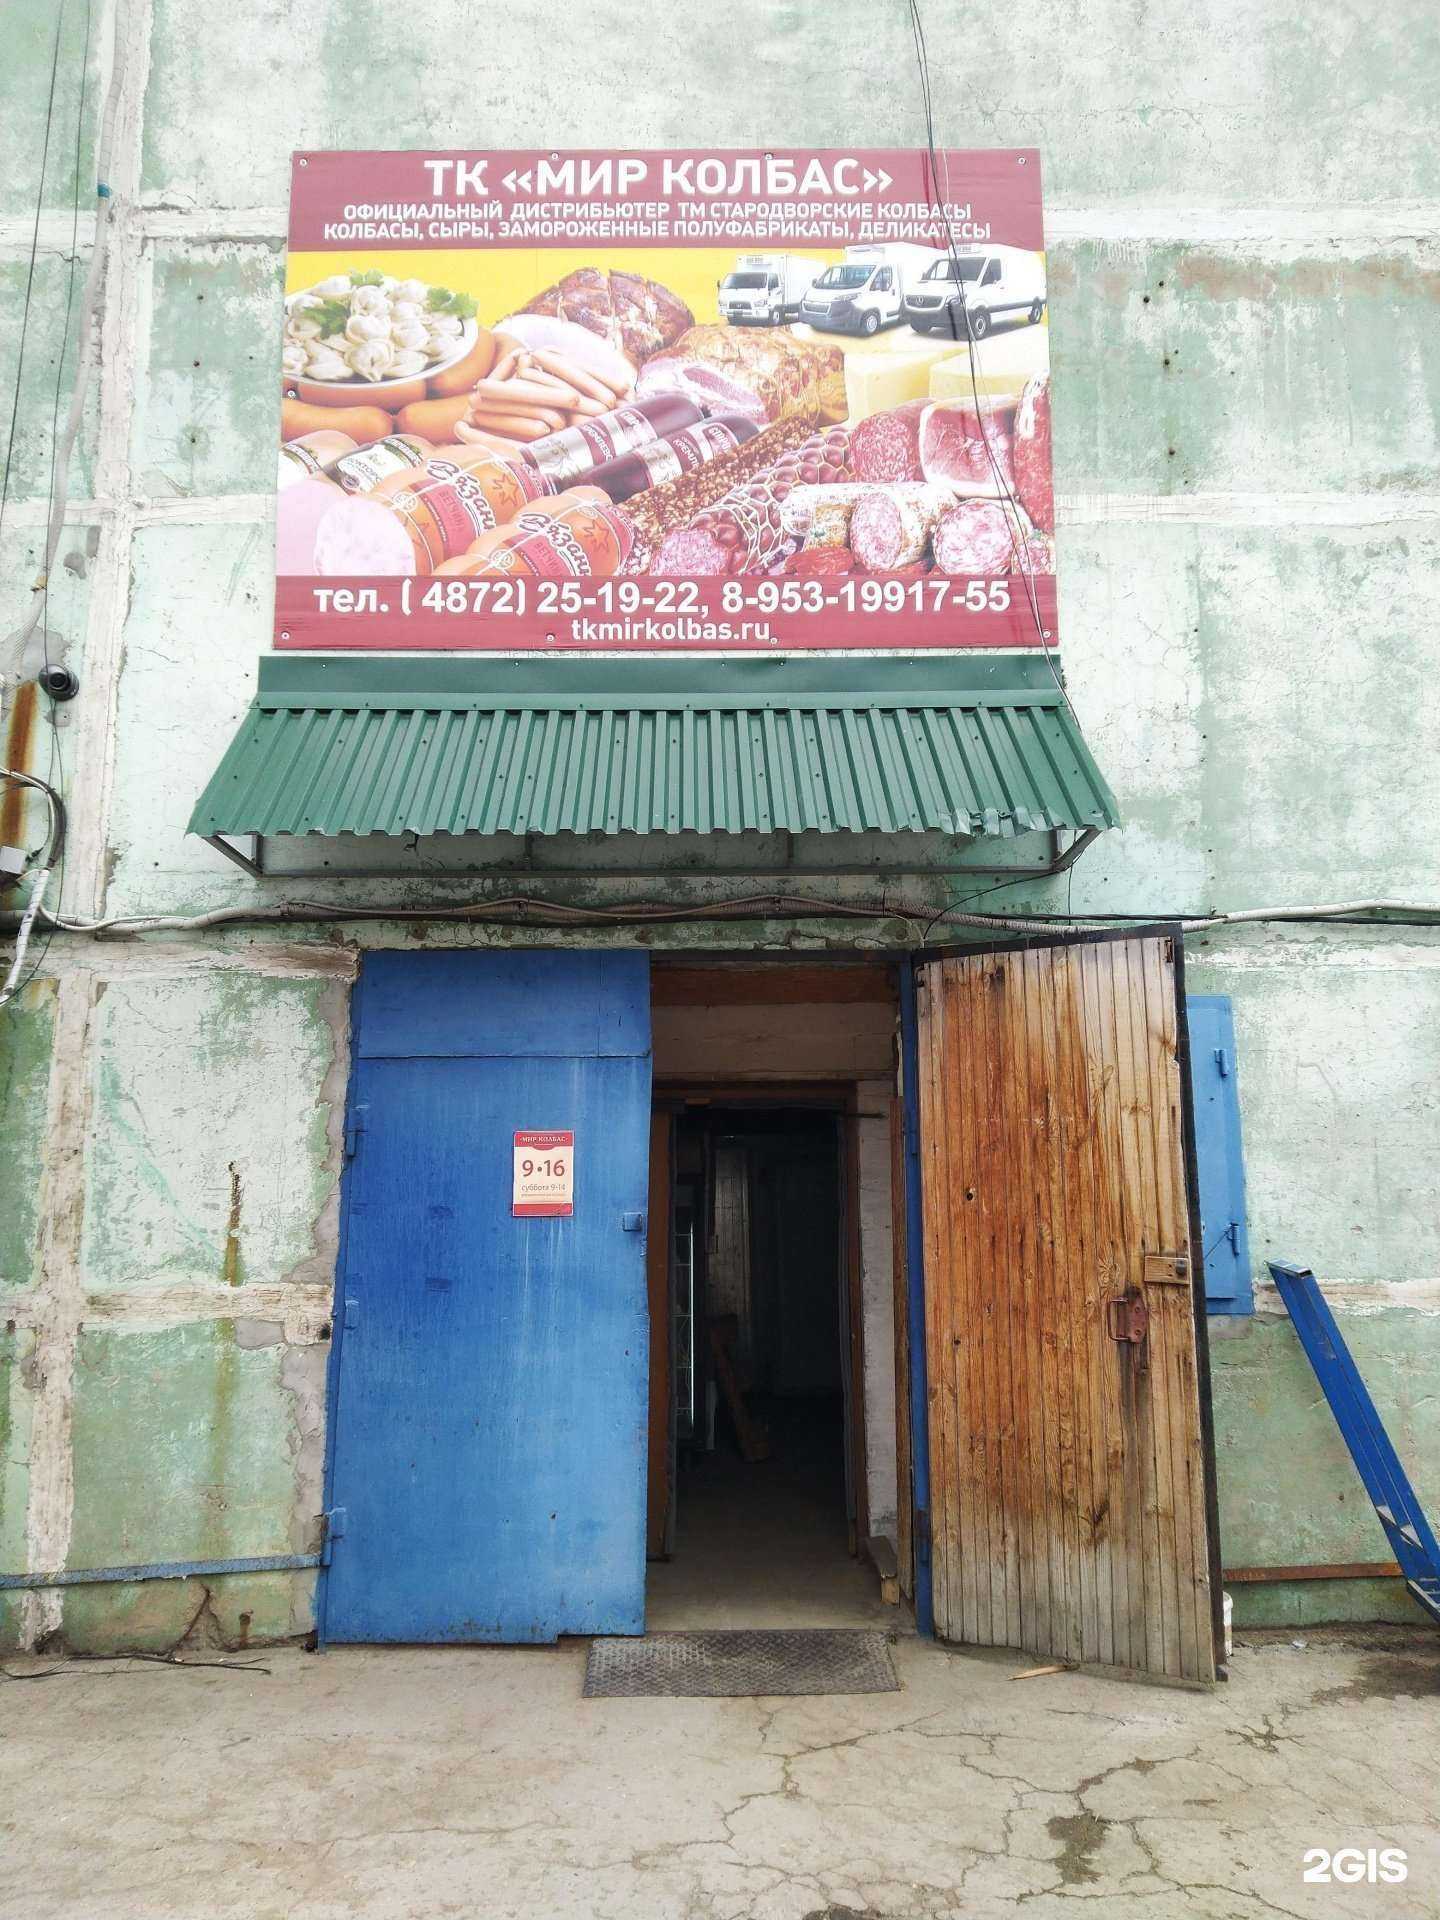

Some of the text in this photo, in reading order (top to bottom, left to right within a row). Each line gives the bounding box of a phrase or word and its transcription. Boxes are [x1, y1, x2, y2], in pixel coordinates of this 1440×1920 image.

[424, 158, 893, 195] ТК «МИР КОЛБАС»
[343, 200, 971, 221] ОФИЦИАЛЬНЫЙ ДИСТРИБЬЮТЕР ТМ СТАРОДВОРСКИЕ КОЛБАСЫ
[324, 220, 991, 241] КОЛБАСЫ, СЫРЫ, ЗАМОРОЖЕННЫЕ ПОЛУФАБРИКАТЫ, ДЕЛИКАТЕСЫ
[313, 588, 389, 613] тел.
[537, 581, 709, 617] 25-19-22,
[721, 581, 1010, 613] 8-953-19917-55
[571, 617, 770, 641] tkmirkolbas.ru
[521, 1183, 549, 1193] суббота
